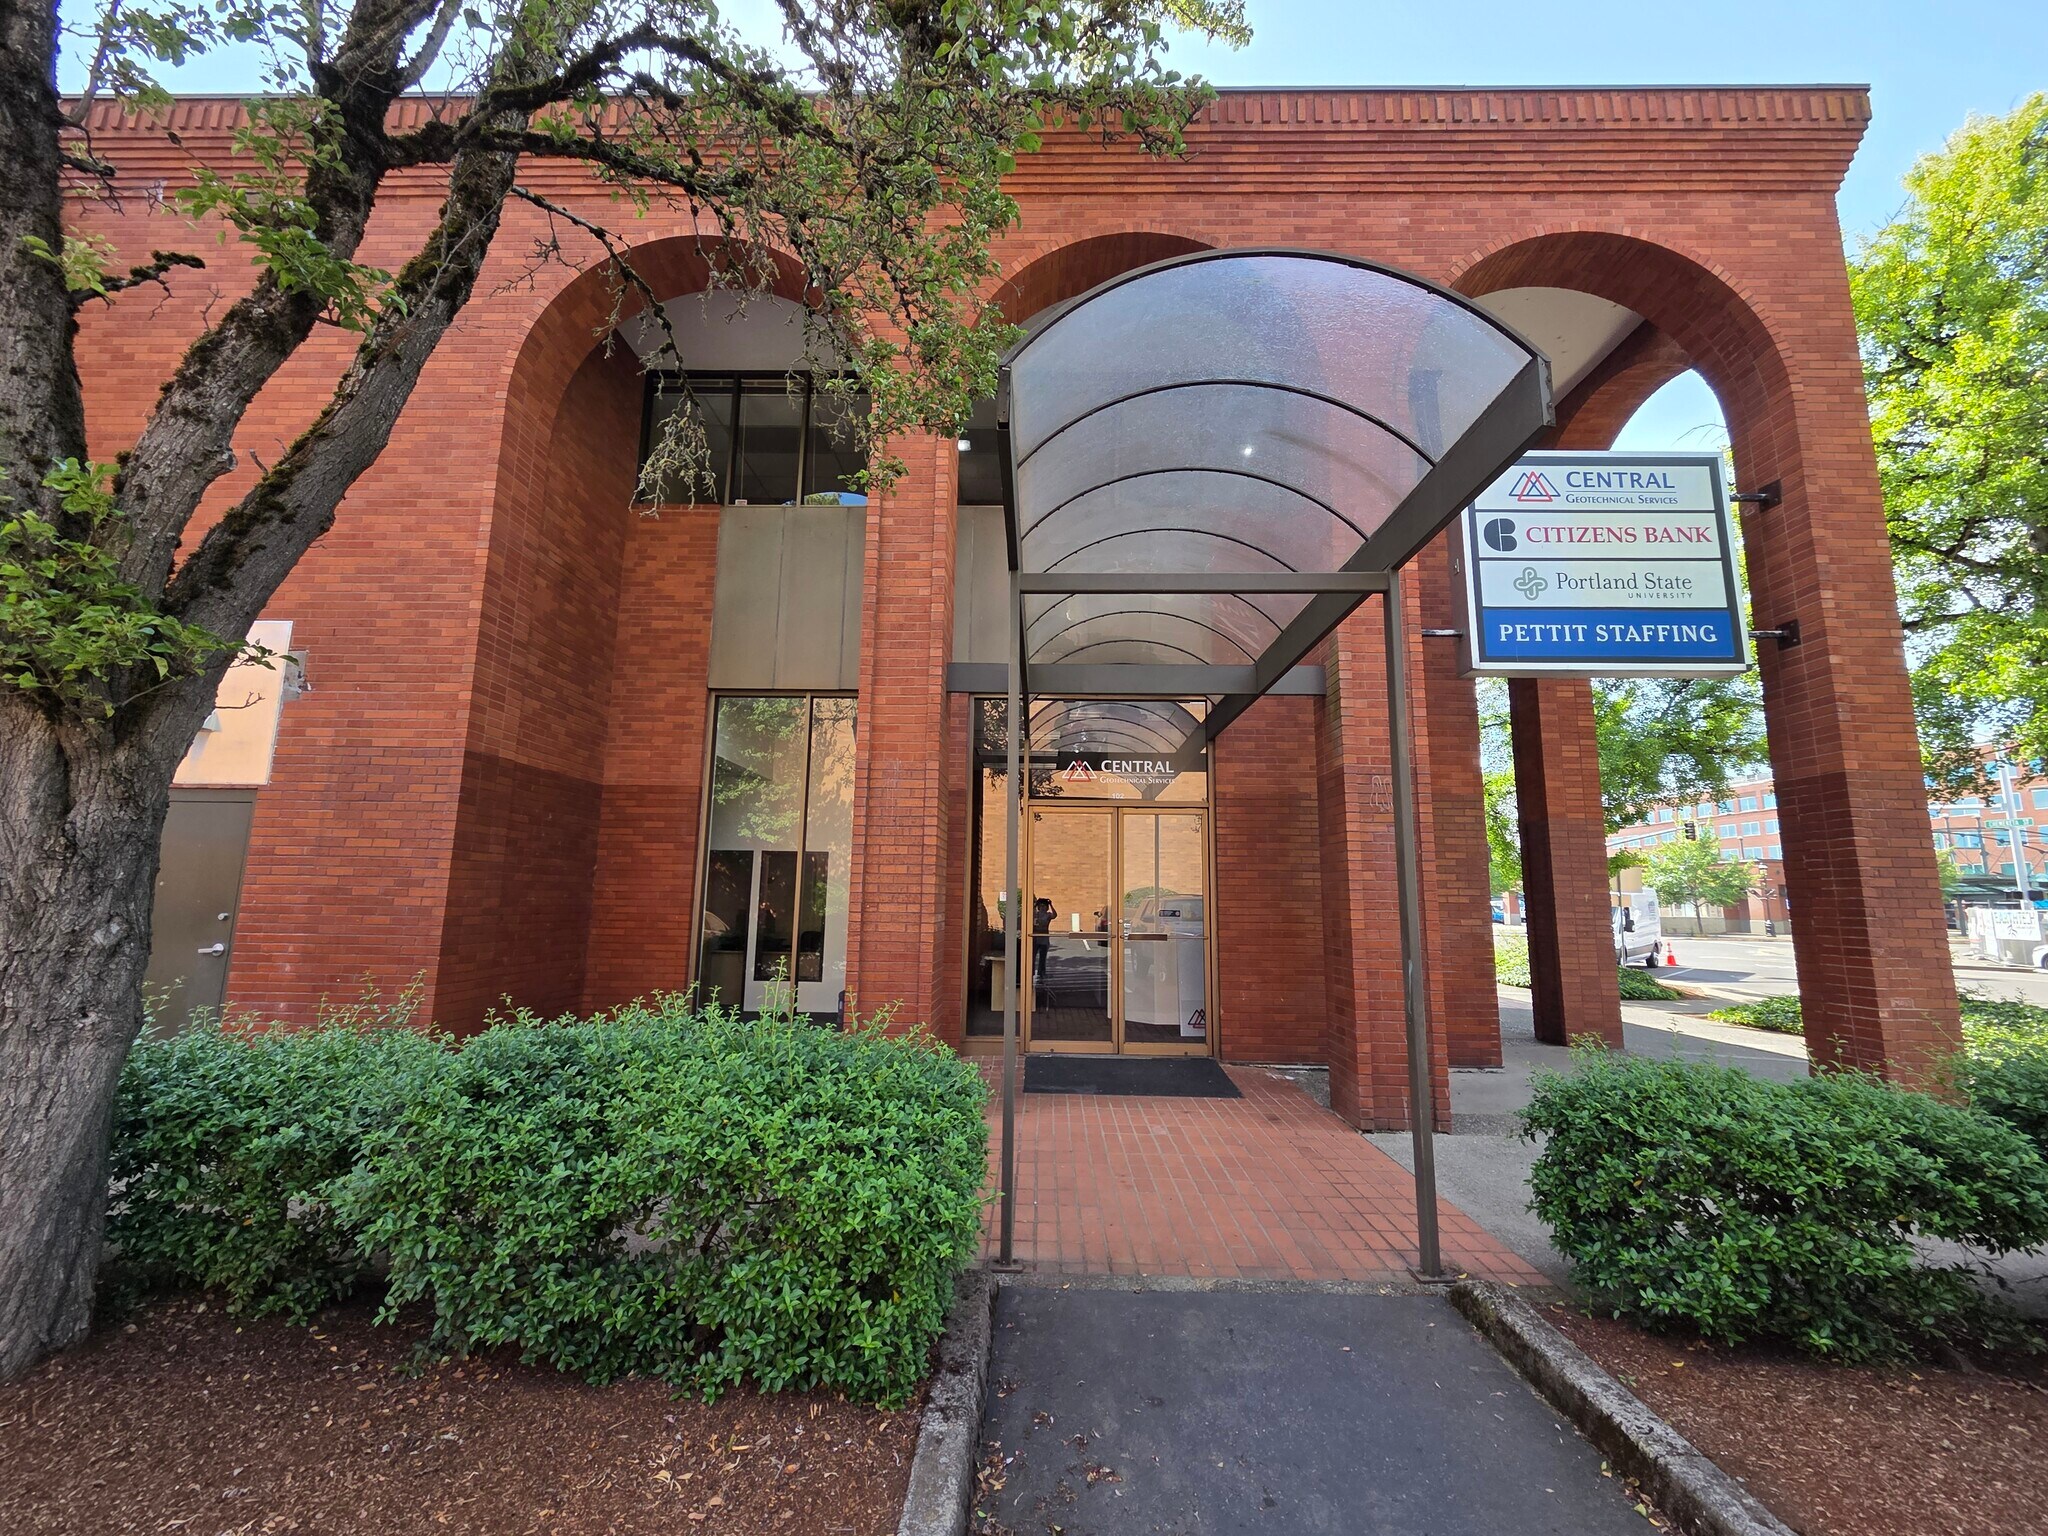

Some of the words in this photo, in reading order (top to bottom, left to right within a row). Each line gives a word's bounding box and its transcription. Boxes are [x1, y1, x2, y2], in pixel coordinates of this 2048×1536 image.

[1565, 471, 1676, 489] CENTRAL
[1565, 493, 1635, 504] GEOTECHNICAL
[1638, 494, 1679, 505] SERVICES
[1525, 526, 1638, 544] CITIZENS
[1643, 526, 1713, 544] BANK
[1556, 572, 1639, 590] Portland
[1644, 572, 1693, 590] State
[1499, 624, 1588, 642] PETTIT
[1595, 625, 1718, 643] STAFFING
[1100, 760, 1175, 773] CENTRAL
